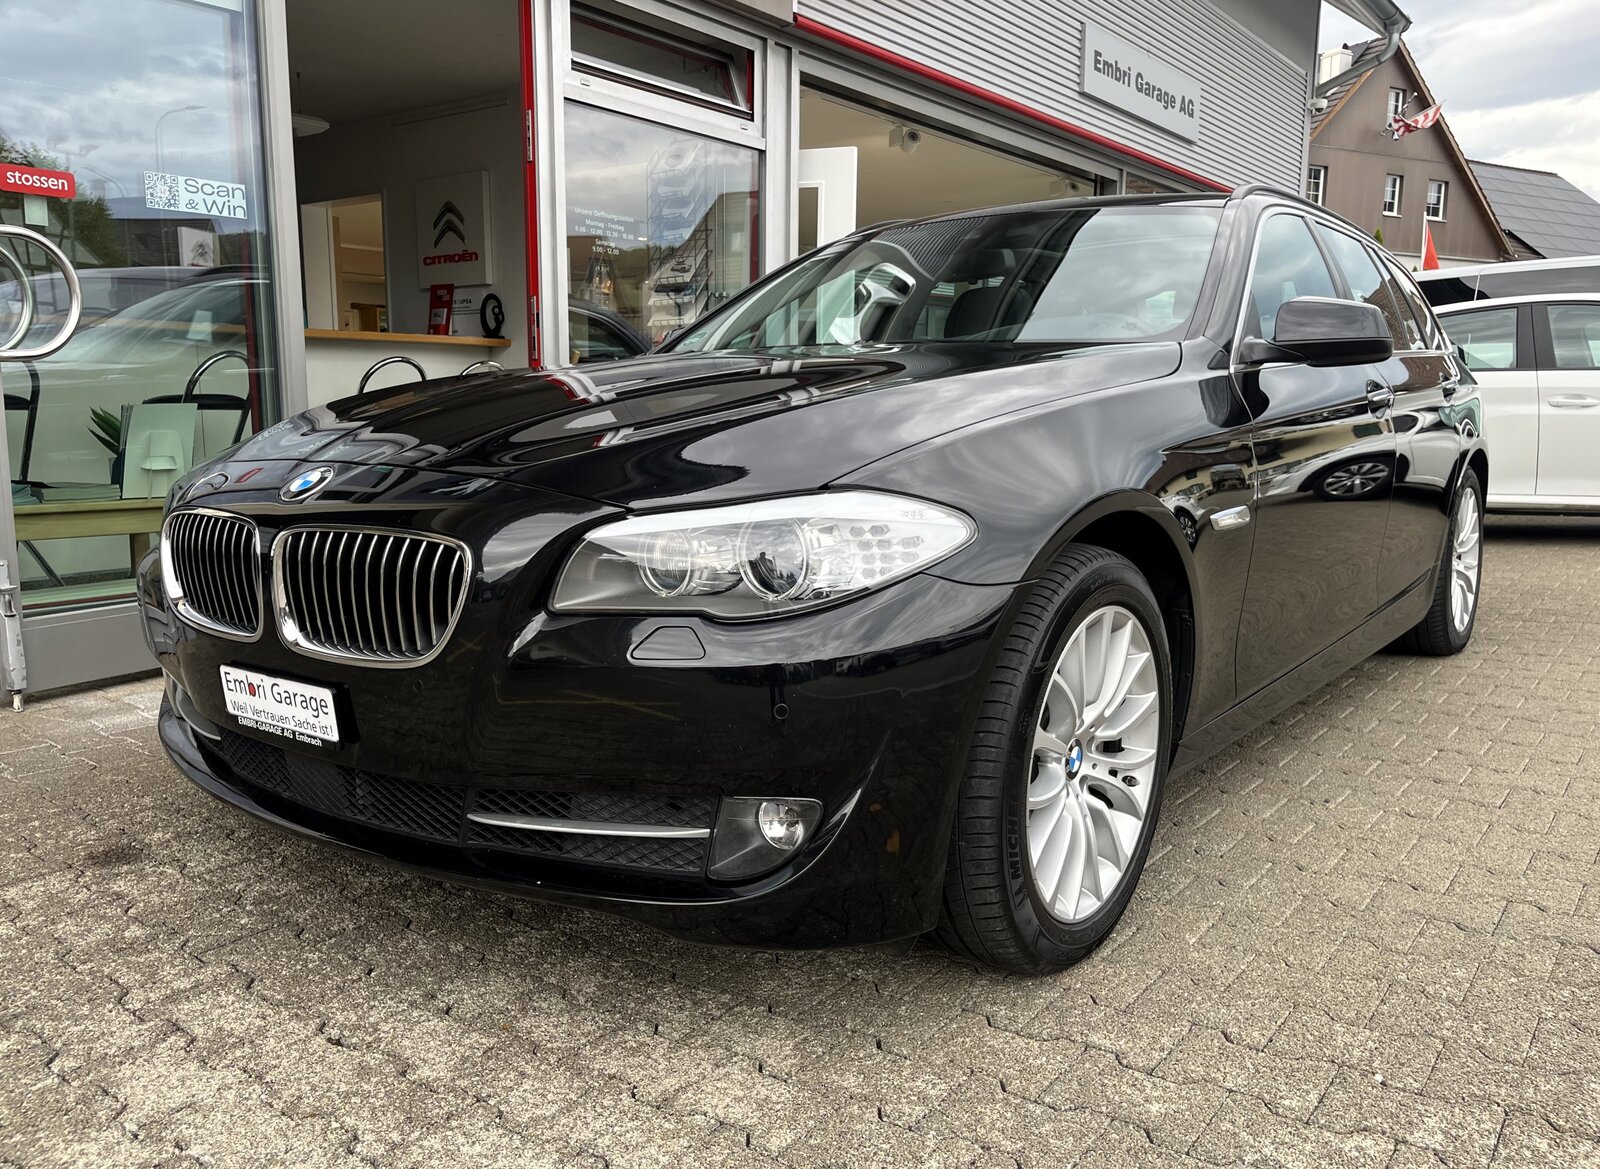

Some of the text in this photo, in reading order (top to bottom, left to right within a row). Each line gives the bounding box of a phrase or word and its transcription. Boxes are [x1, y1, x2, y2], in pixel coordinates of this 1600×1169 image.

[1093, 49, 1195, 119] Embri Garage AG
[6, 170, 69, 191] stossen
[184, 178, 246, 200] Scan
[185, 198, 247, 218] & Win
[574, 207, 593, 216] Unsere
[585, 218, 604, 228] Montag
[608, 222, 625, 232] Freitag
[224, 671, 329, 719] Embri Garage
[230, 699, 248, 715] Weil
[249, 704, 291, 727] Vertrauen
[292, 715, 317, 733] Sache
[283, 729, 294, 739] AG
[295, 731, 322, 747] Embrach
